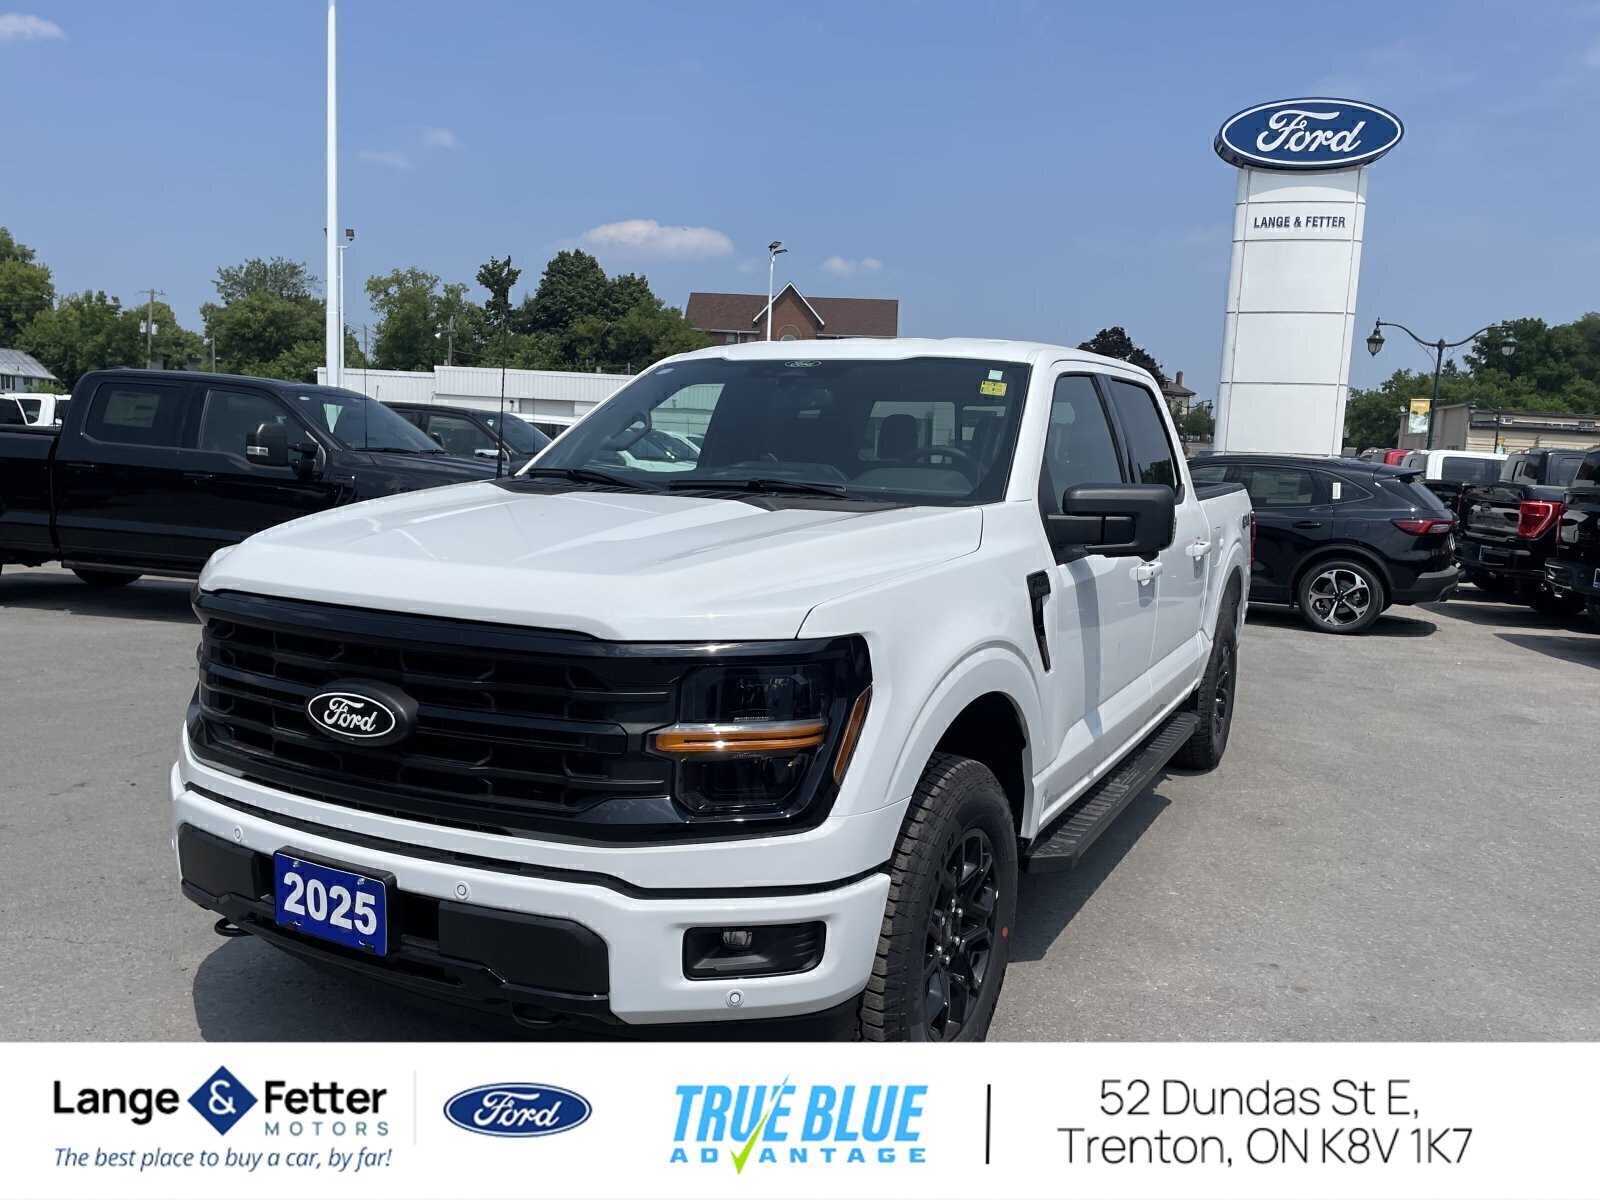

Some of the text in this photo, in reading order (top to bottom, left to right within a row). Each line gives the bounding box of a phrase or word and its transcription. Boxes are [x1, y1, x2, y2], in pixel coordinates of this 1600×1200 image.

[1256, 109, 1366, 153] Ford
[1253, 216, 1346, 229] LANGE & FETTER
[323, 697, 377, 733] Ford
[283, 872, 378, 936] 2025
